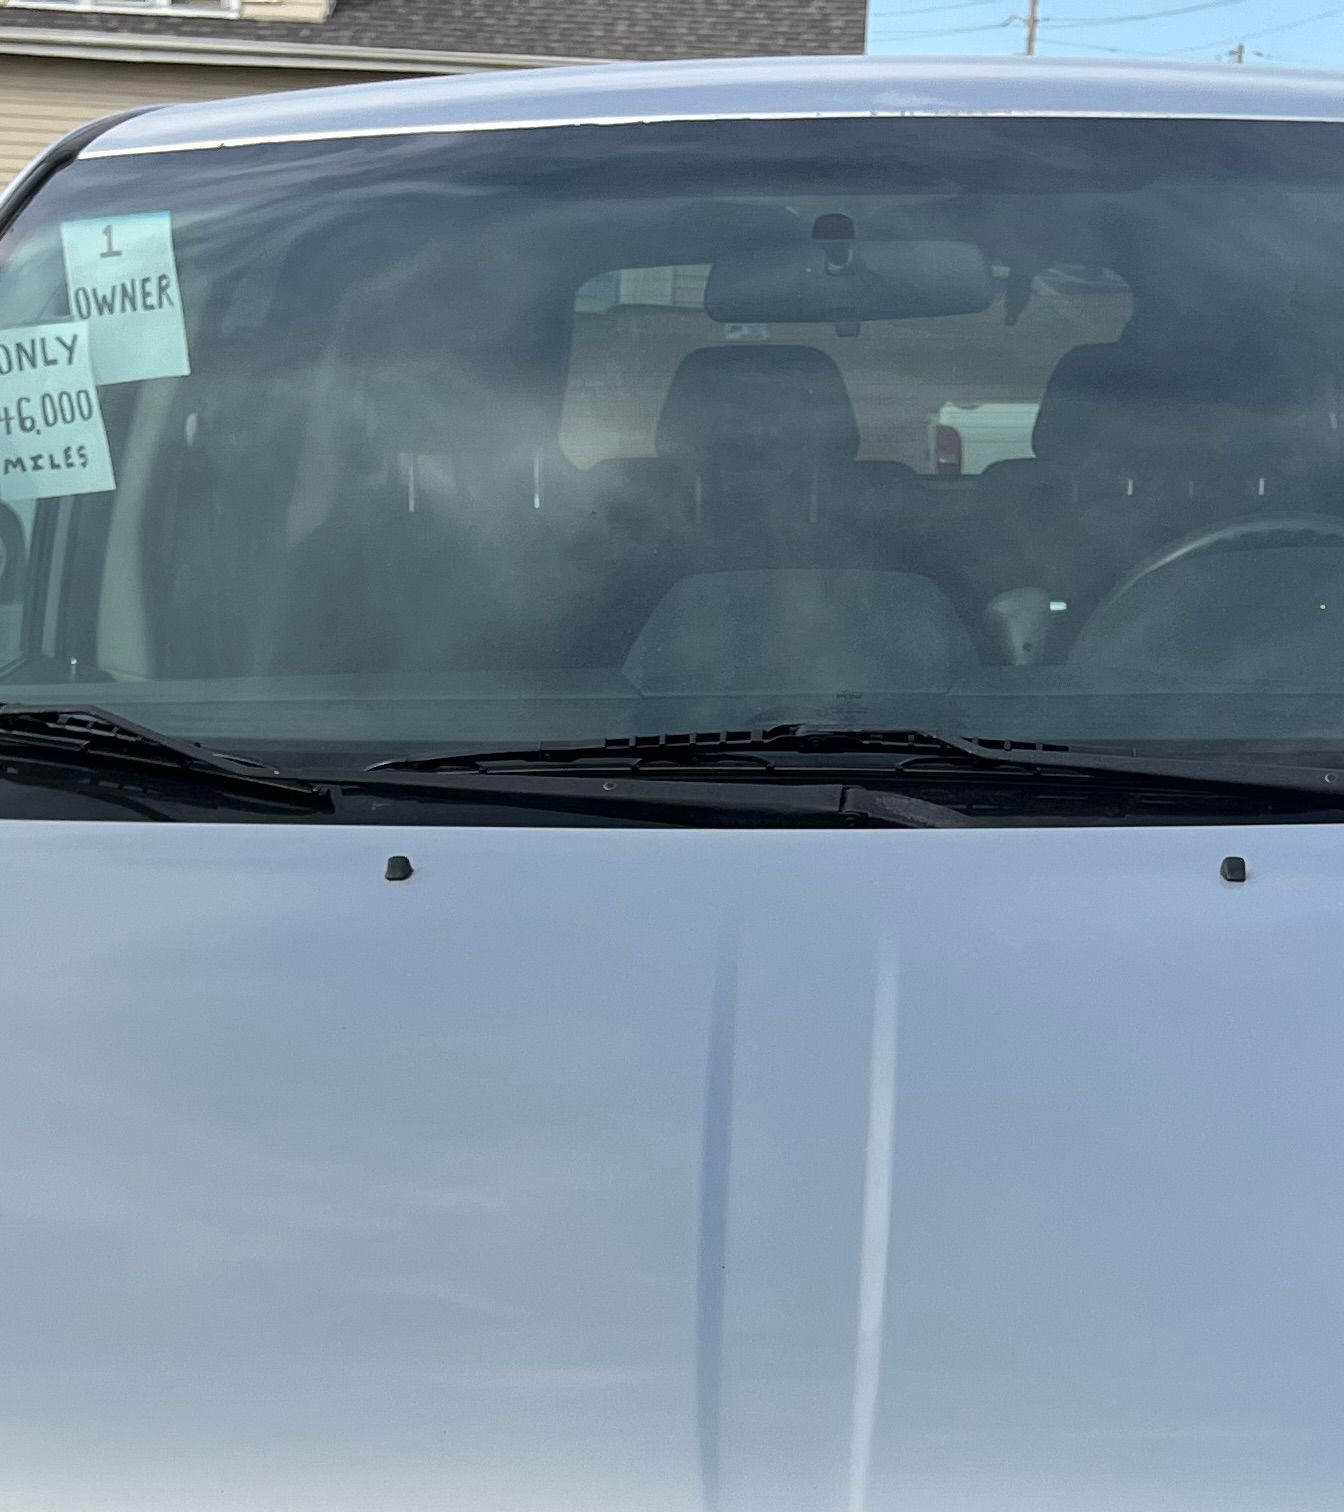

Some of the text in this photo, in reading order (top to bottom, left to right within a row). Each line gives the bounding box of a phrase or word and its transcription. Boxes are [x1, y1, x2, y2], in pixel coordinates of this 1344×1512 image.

[99, 224, 122, 258] 1
[73, 272, 175, 321] OWNER
[2, 444, 90, 476] MILES
